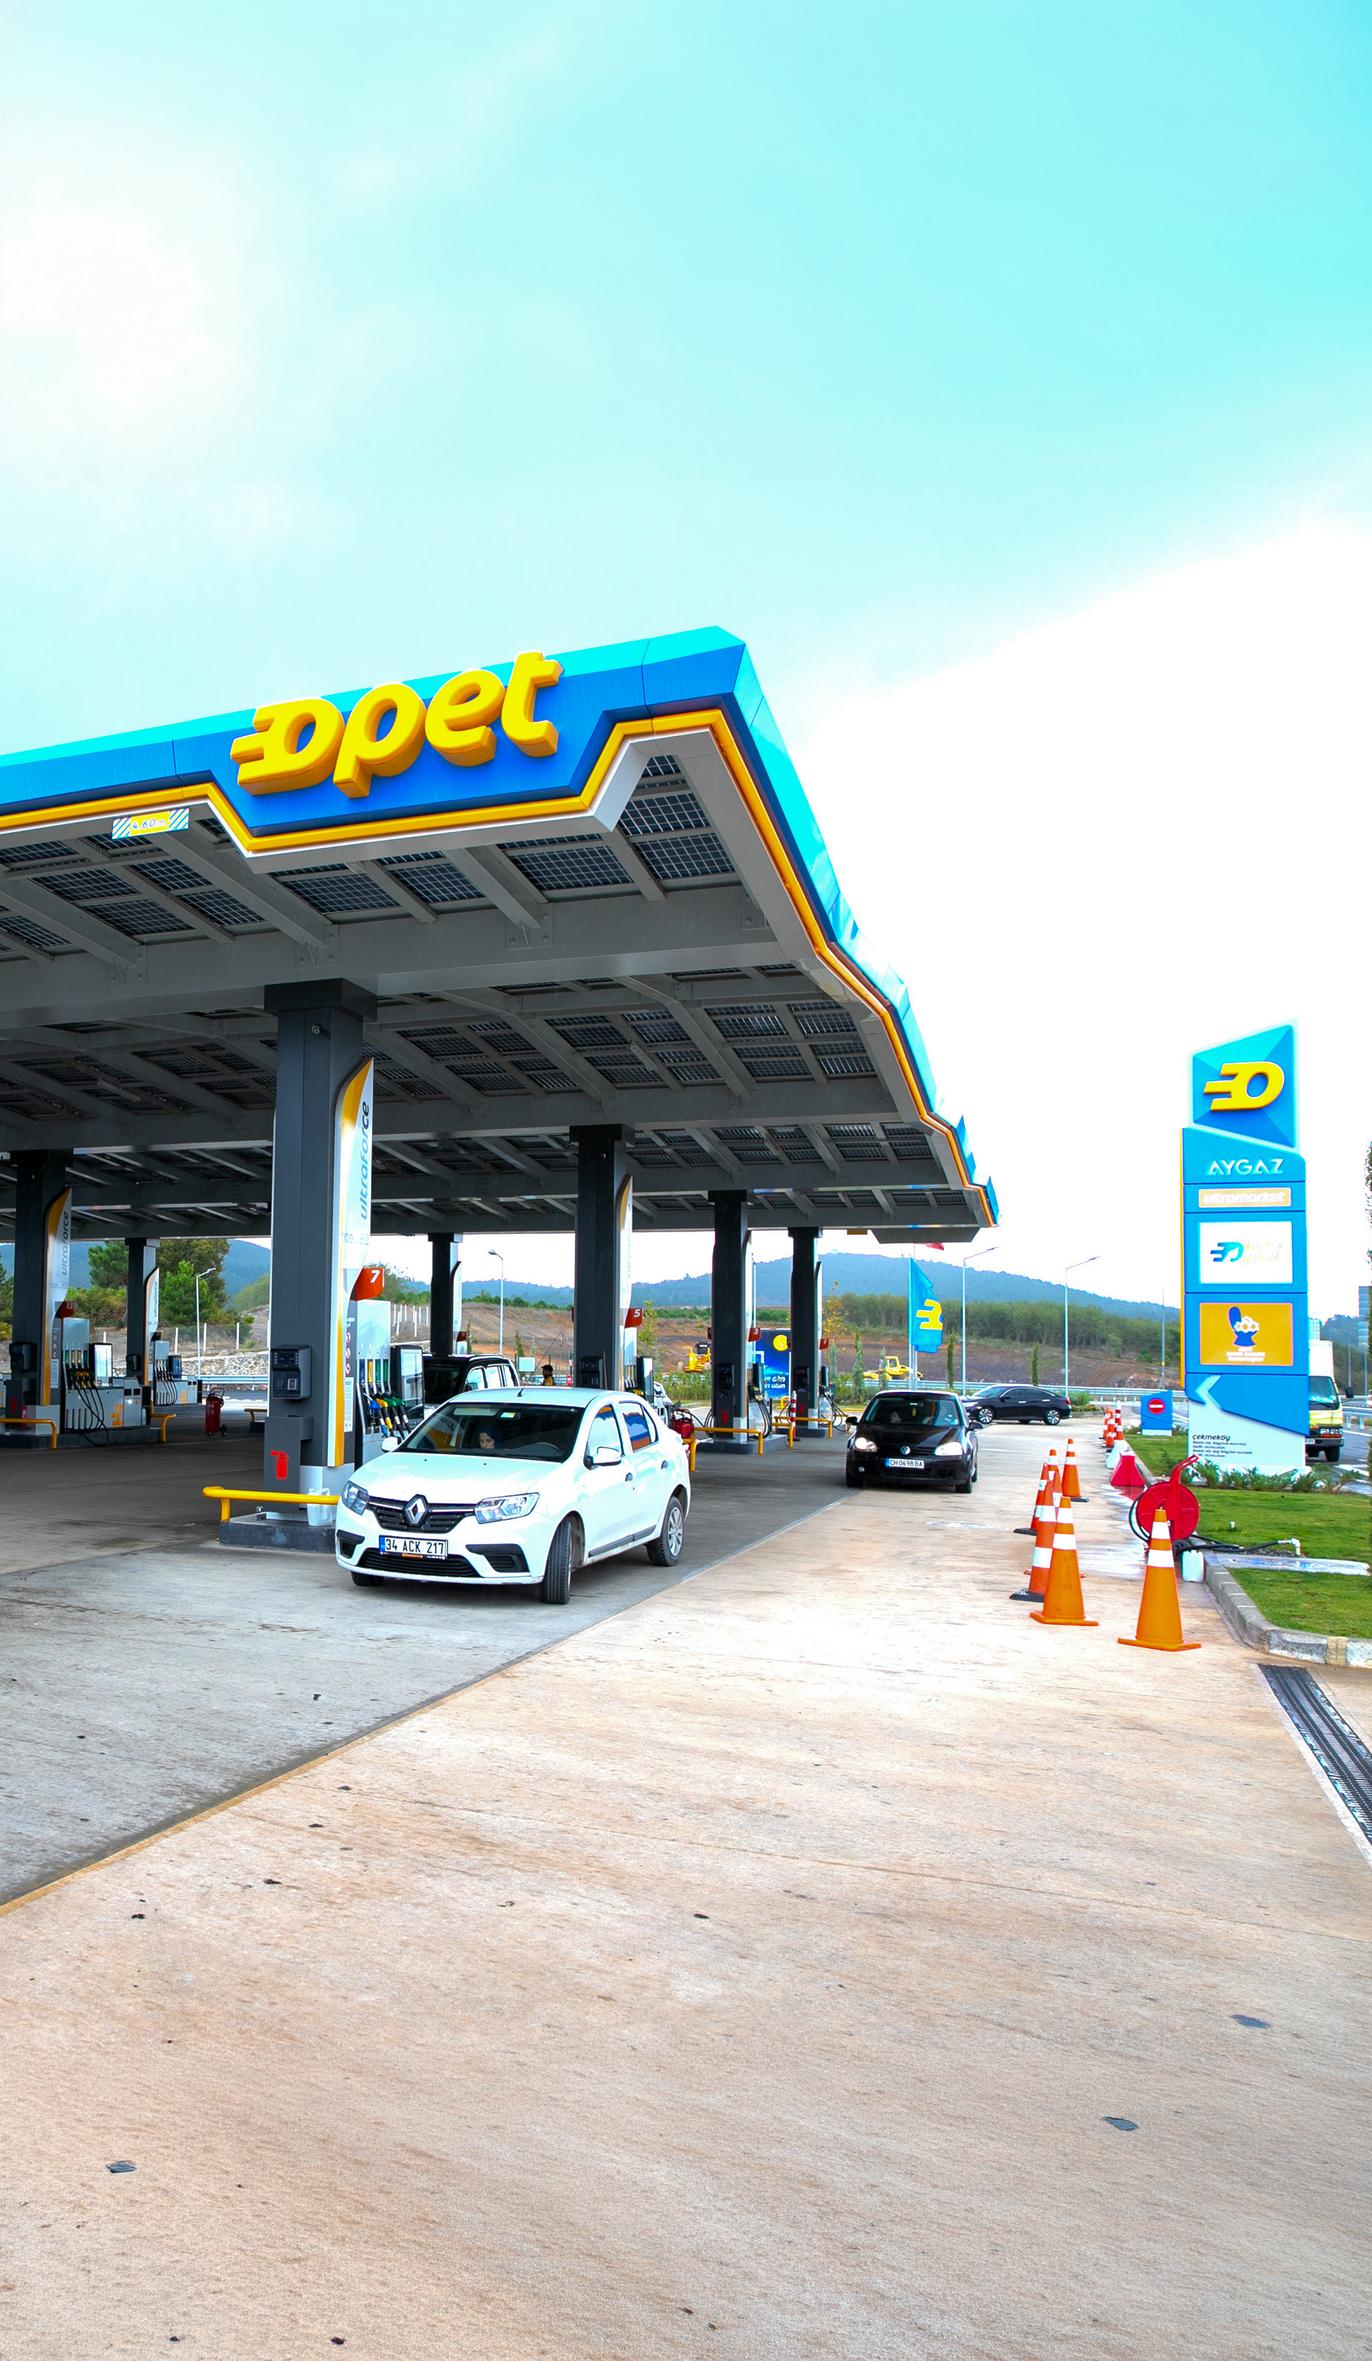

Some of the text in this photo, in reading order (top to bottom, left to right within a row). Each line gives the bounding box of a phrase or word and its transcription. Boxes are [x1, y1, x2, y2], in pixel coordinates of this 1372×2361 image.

[230, 651, 564, 798] opet
[360, 1101, 369, 1220] ultraforce
[1205, 1159, 1284, 1176] AYGAZ
[370, 1270, 380, 1283] 7
[633, 1309, 641, 1317] 5
[385, 1538, 444, 1555] 34 ACK 217
